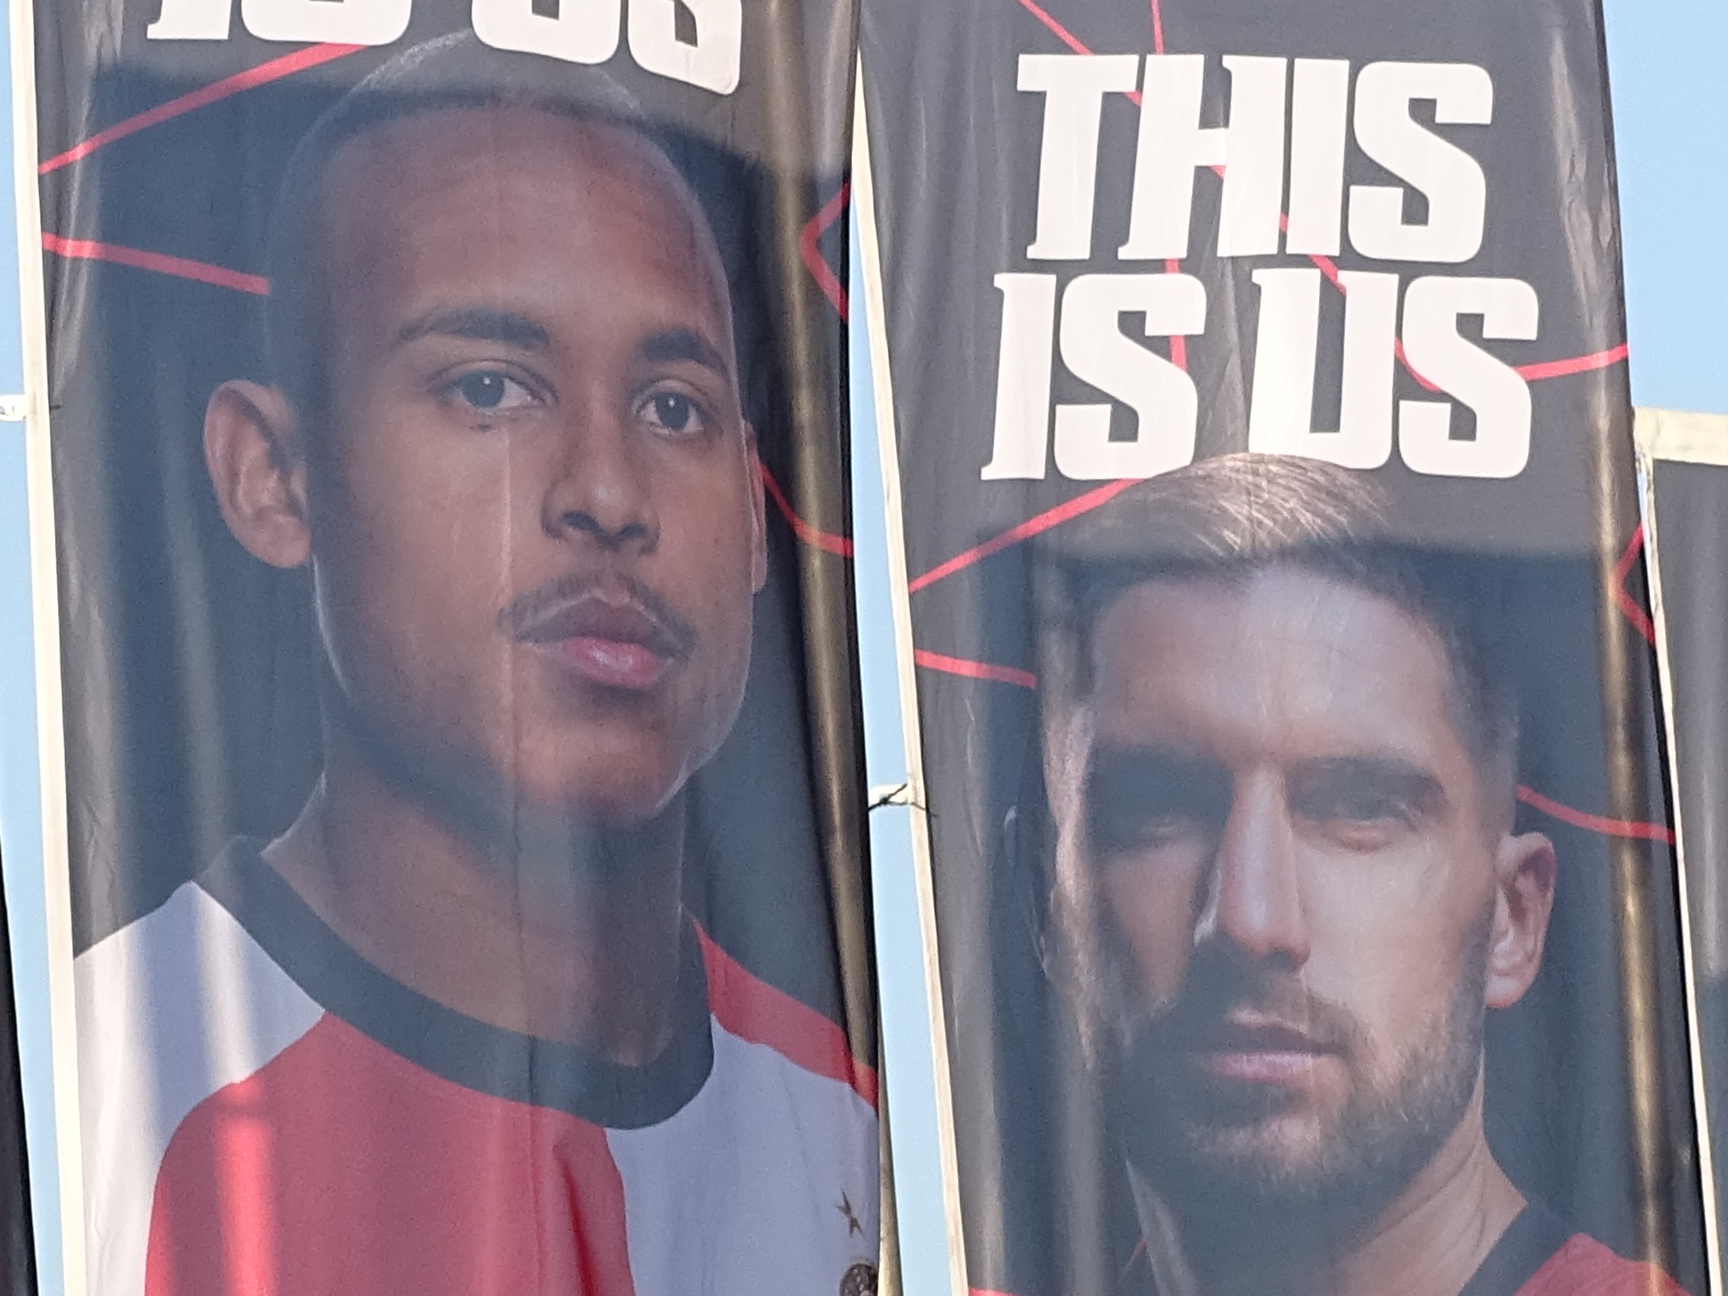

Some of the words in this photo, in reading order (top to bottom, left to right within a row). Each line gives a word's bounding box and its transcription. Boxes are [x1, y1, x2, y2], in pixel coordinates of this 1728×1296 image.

[1016, 54, 1493, 262] THIS
[981, 272, 1207, 480] IS
[1248, 268, 1539, 478] US
